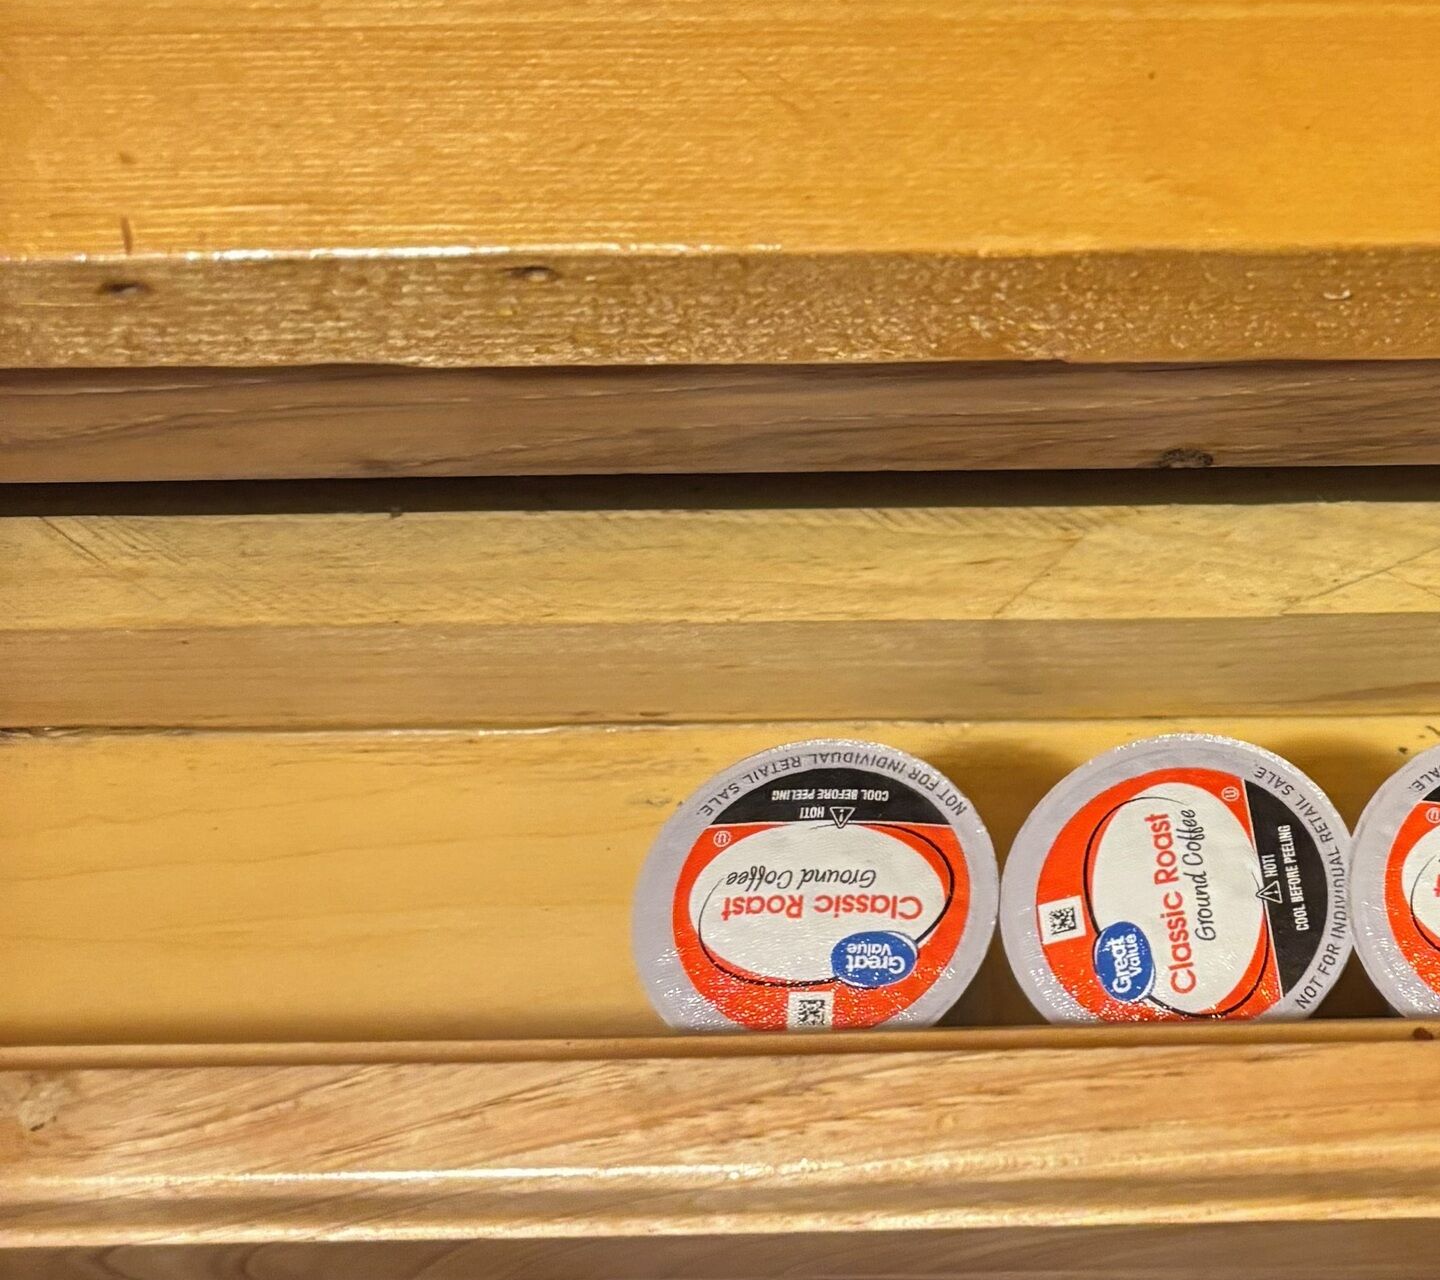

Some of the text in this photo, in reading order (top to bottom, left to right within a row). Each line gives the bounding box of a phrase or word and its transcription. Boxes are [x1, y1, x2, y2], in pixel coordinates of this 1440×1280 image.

[741, 756, 800, 784] RETAIL
[808, 752, 905, 773] INDIVIDUAL
[908, 768, 939, 791] FOR
[772, 789, 889, 801] COOL BEFORE PEELING
[937, 789, 967, 816] NOT
[800, 807, 824, 818] HOT!
[1296, 793, 1331, 845] RETAIL
[727, 865, 876, 891] Ground Coffee
[1180, 810, 1216, 941] Ground Coffee
[1263, 854, 1278, 878] HOT!
[1278, 825, 1310, 931] COOL BEFORE PEELING
[721, 895, 923, 921] Classic Roast
[1144, 813, 1197, 994] Classic Roast
[846, 943, 892, 955] Value
[1127, 934, 1142, 976] Value
[1318, 941, 1340, 974] FOR
[845, 955, 906, 974] Great
[1108, 936, 1131, 994] Great
[1296, 972, 1323, 1009] NOT
